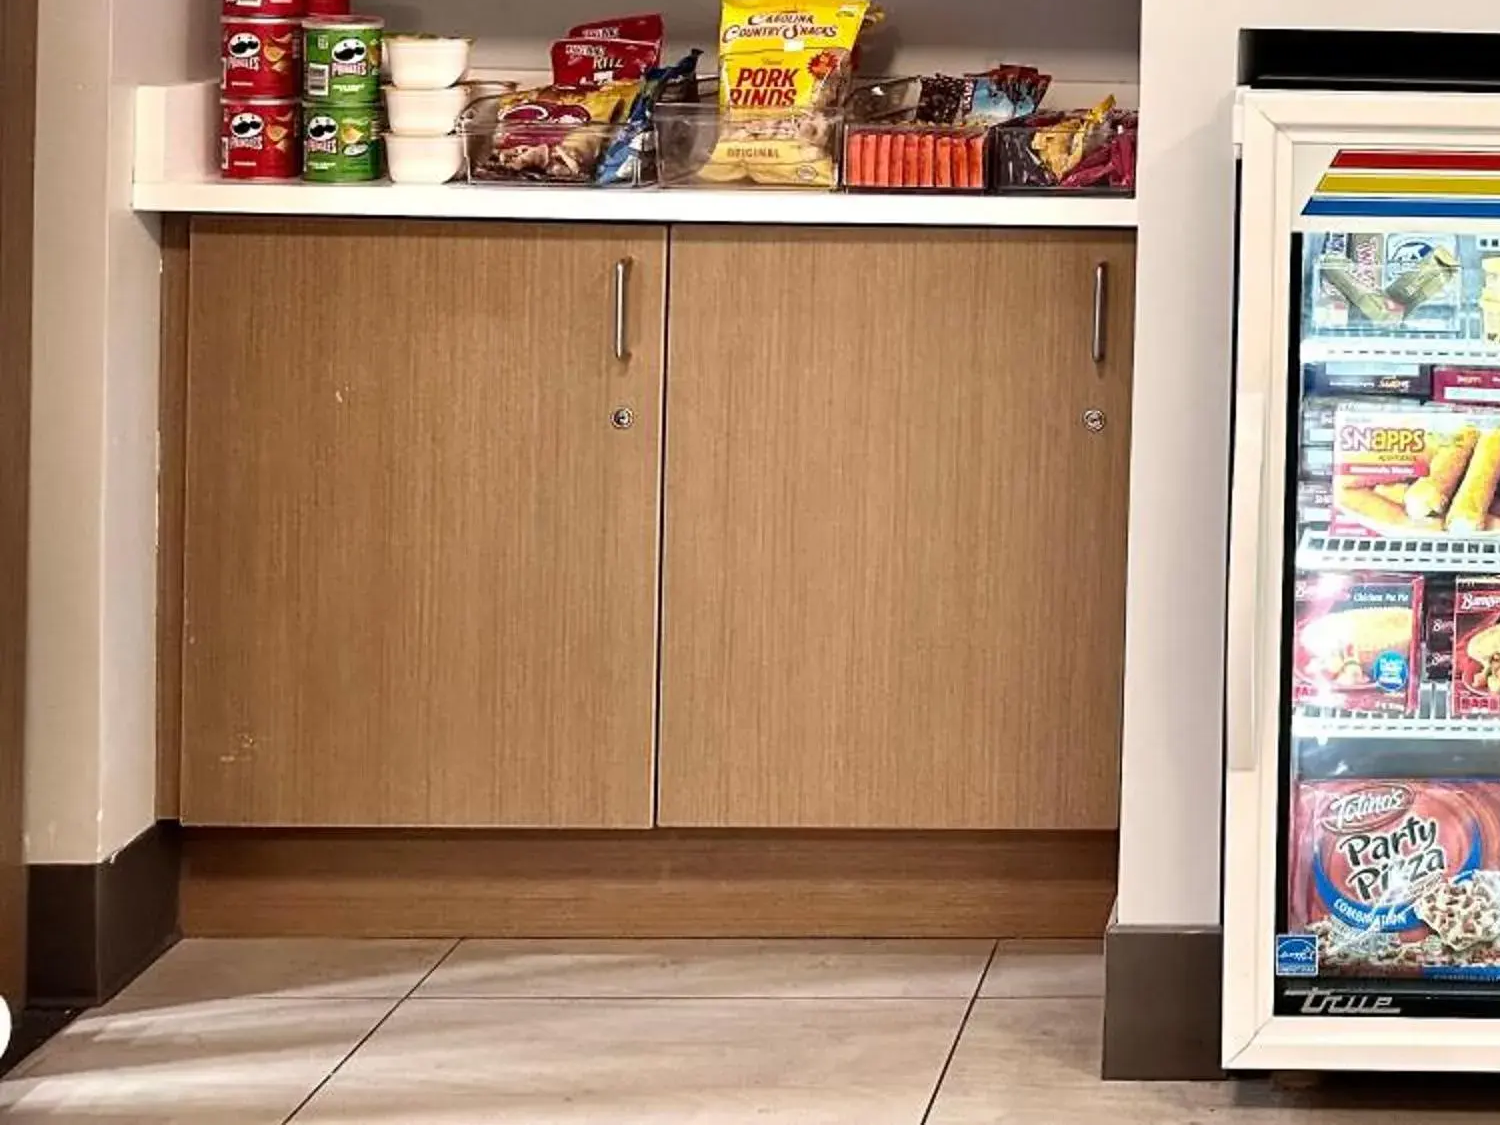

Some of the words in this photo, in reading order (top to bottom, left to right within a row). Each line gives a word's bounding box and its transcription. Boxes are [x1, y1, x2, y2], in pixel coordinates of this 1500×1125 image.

[783, 26, 838, 40] SNACKS
[736, 67, 800, 88] PORK
[729, 87, 797, 108] RINDS
[1329, 788, 1405, 827] Totino's
[1340, 817, 1438, 867] Party
[1348, 848, 1446, 901] Piza
